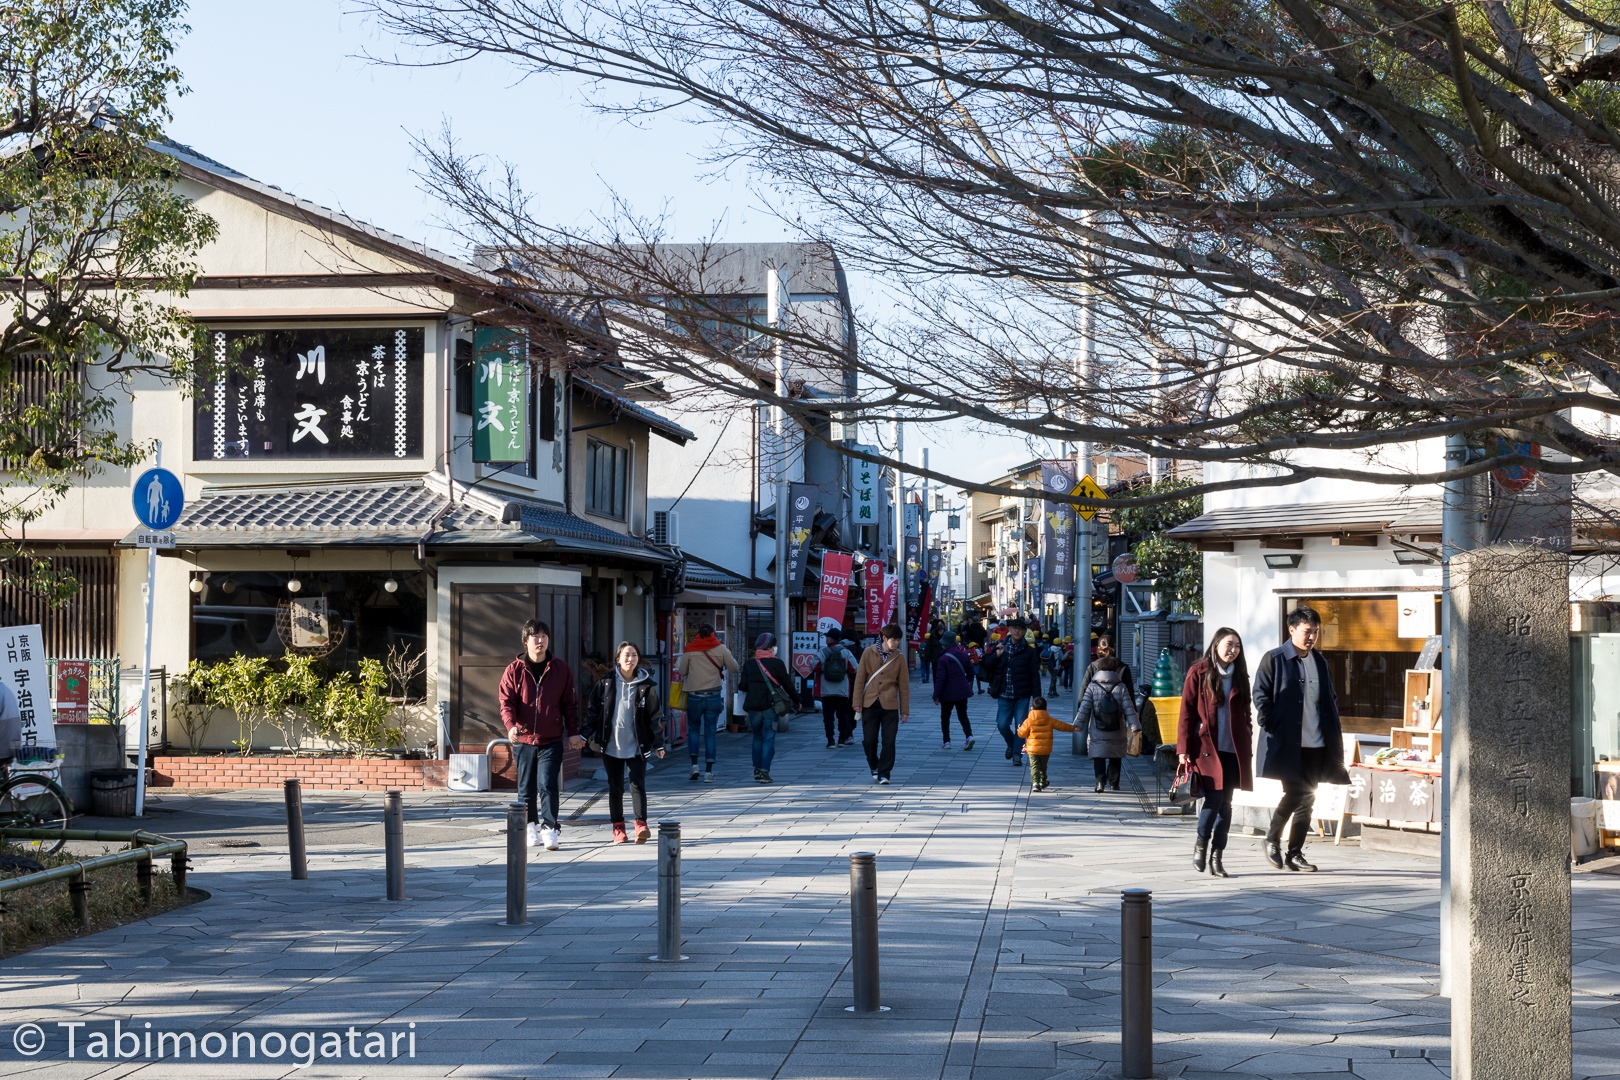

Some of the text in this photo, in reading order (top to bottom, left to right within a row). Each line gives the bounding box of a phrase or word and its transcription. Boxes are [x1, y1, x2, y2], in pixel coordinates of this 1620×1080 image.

[372, 345, 386, 388] 茶そば
[253, 355, 266, 422] お二階席も
[292, 345, 329, 444] 川文
[356, 360, 370, 422] 京うどん
[477, 357, 505, 432] 川文
[236, 385, 250, 455] ございます。
[340, 394, 354, 438] 食事処
[138, 535, 175, 545] 自転車を除く
[823, 585, 844, 596] Free
[869, 588, 883, 603] 5%
[7, 636, 18, 664] JR
[18, 634, 32, 662] 京阪
[58, 667, 88, 681] ヤサカタクシー
[1504, 614, 1535, 818] 昭和十五年三月
[1348, 773, 1430, 806] 宇治茶
